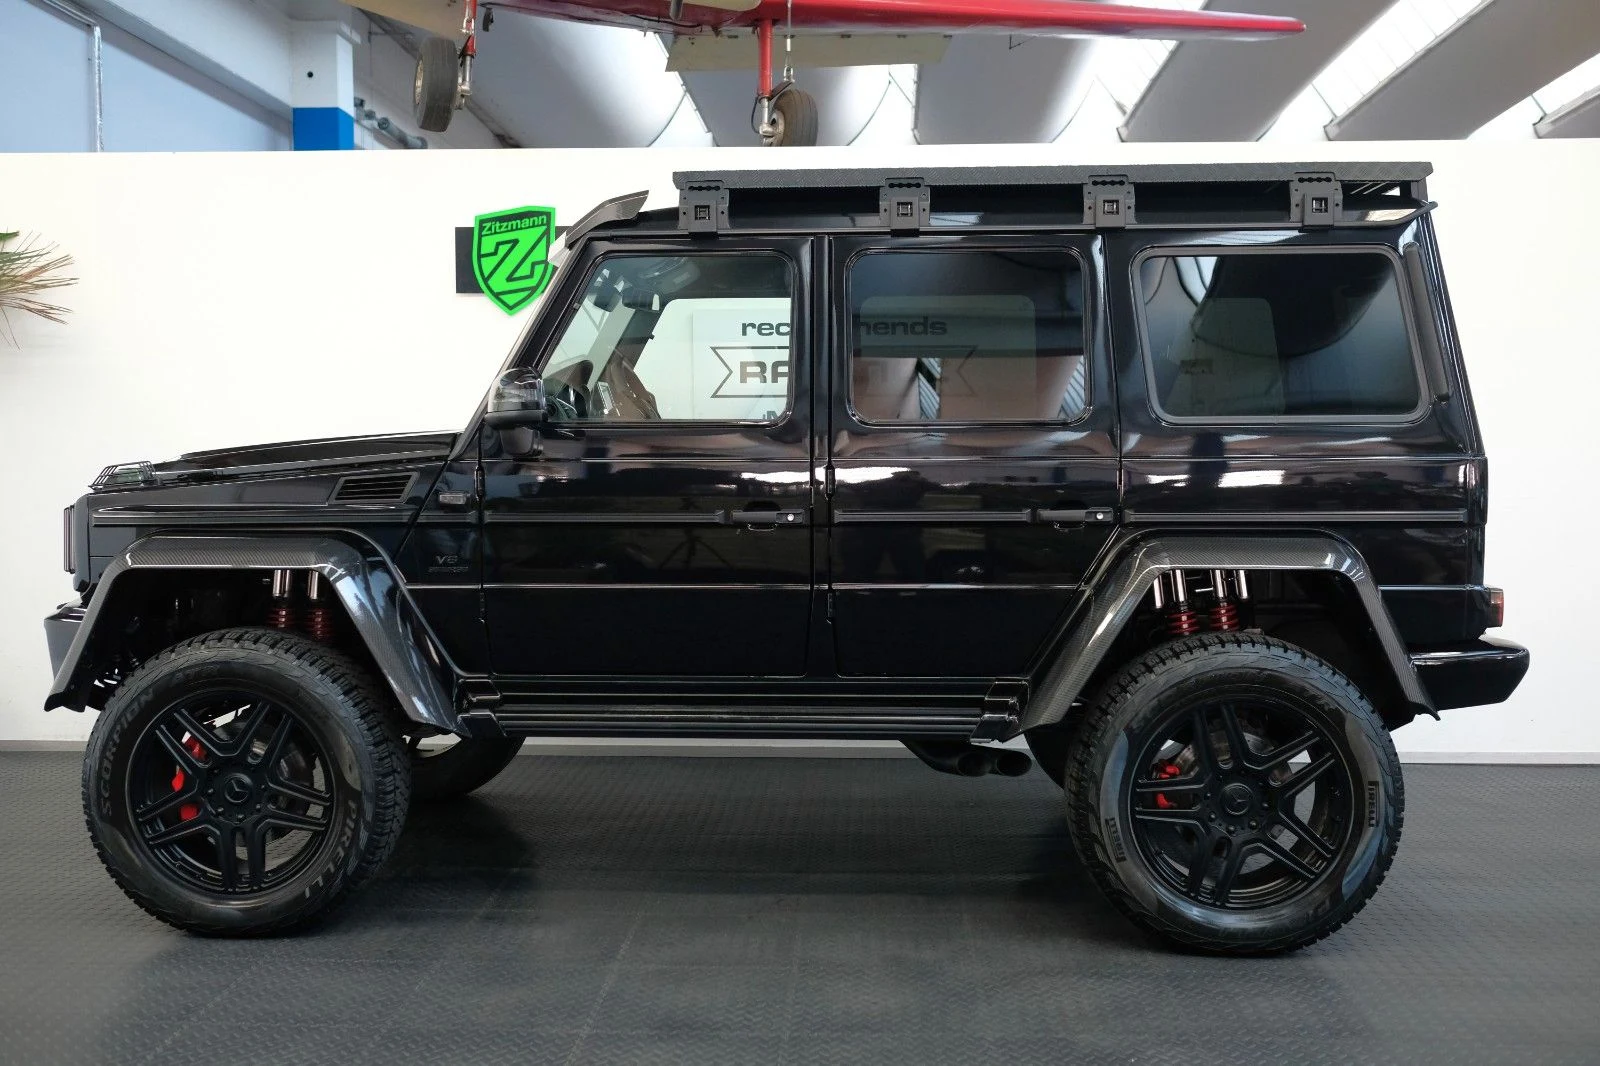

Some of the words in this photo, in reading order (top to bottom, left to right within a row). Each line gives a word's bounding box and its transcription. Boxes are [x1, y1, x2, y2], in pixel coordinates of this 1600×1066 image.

[482, 214, 547, 235] Zitzmann
[101, 688, 155, 816] SCORPION
[304, 799, 358, 899] PIRELLI
[1105, 817, 1127, 863] PIRELLI
